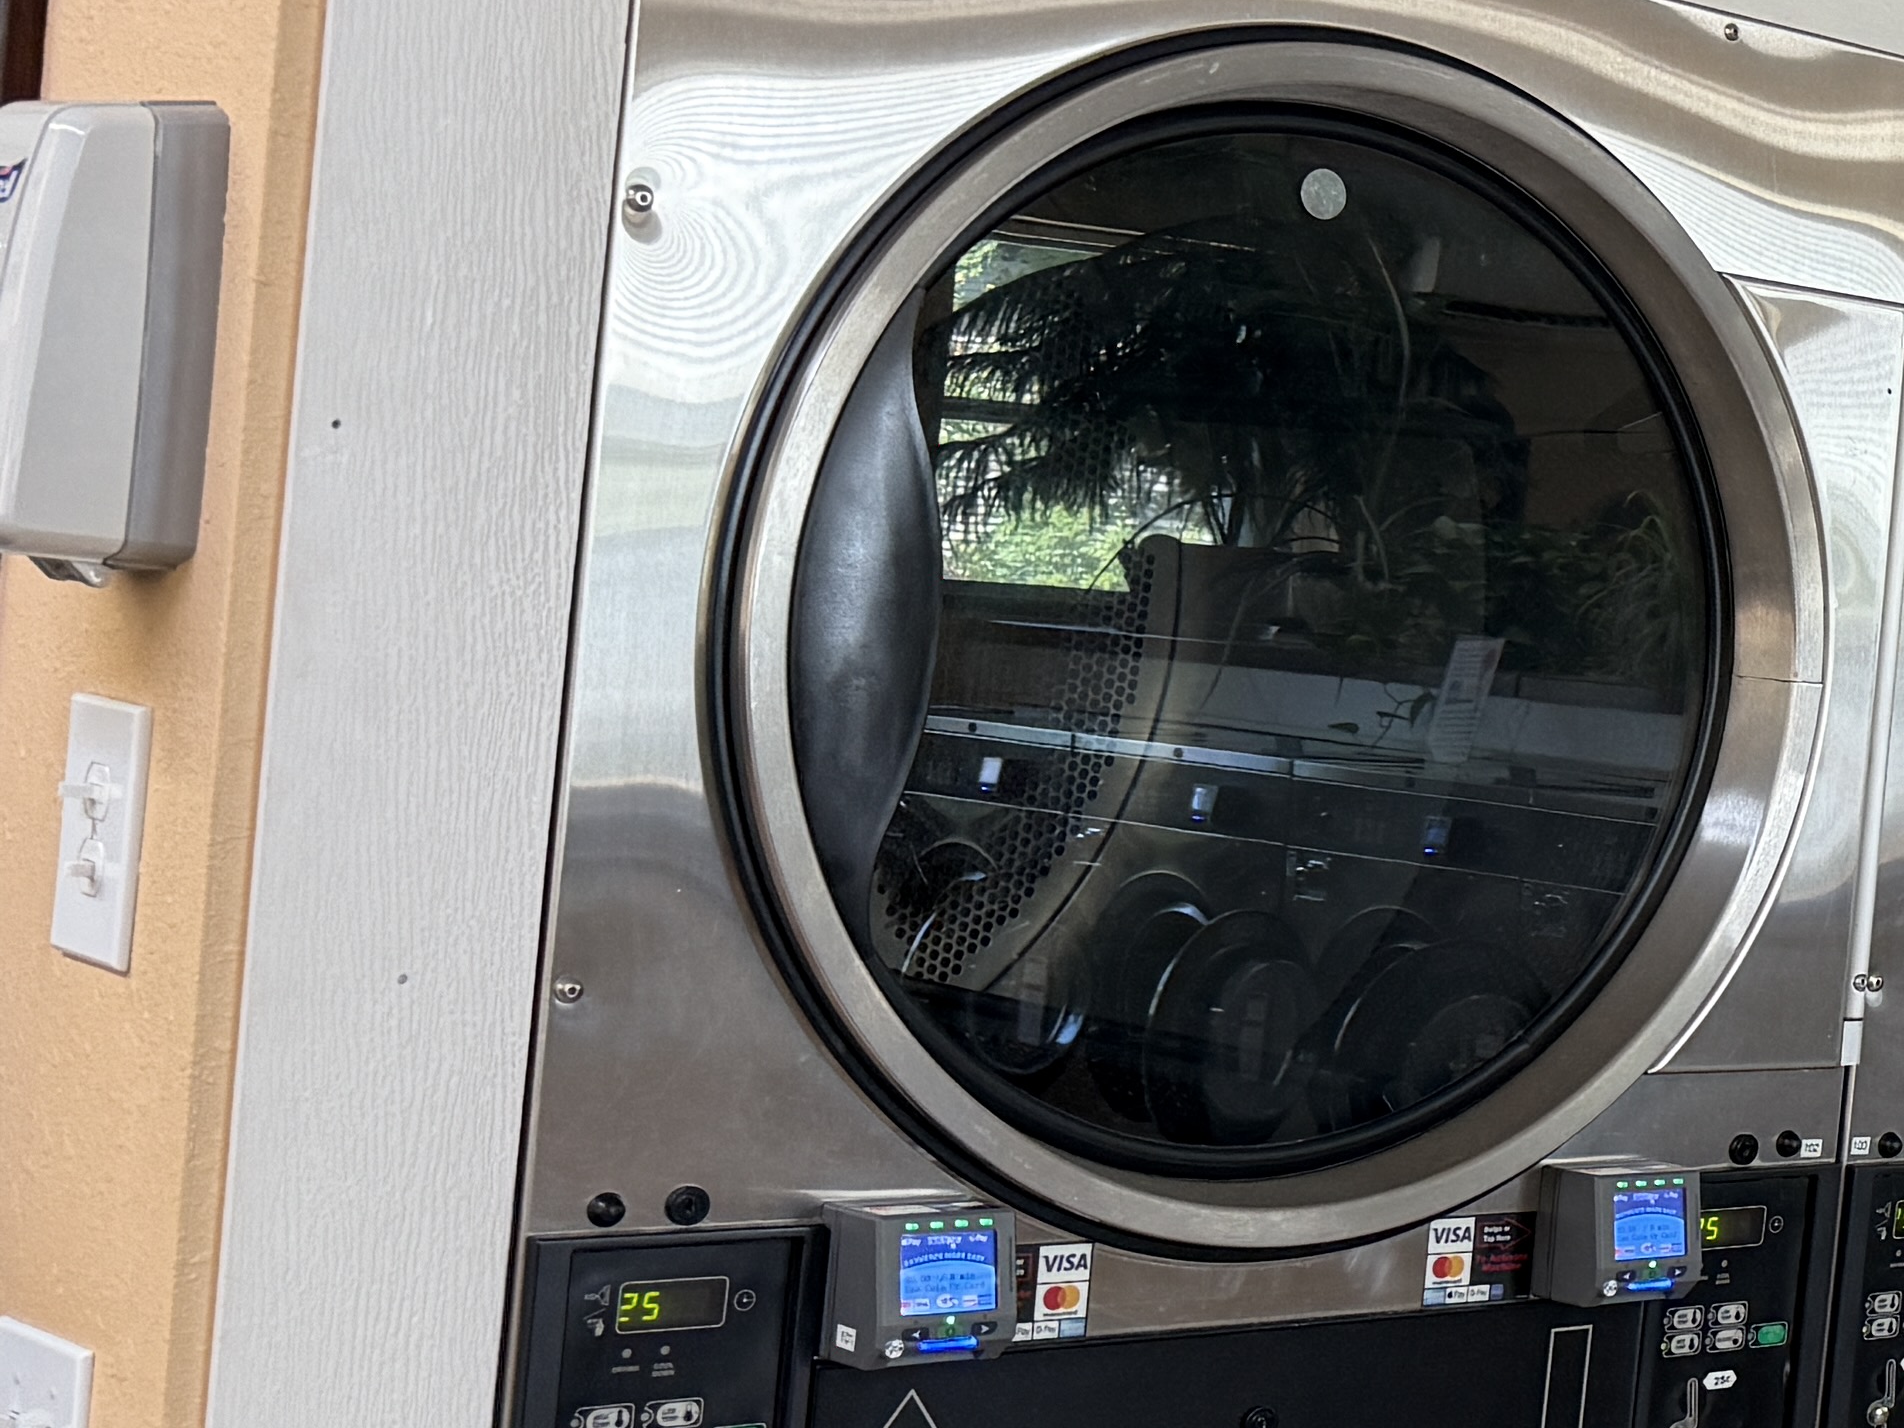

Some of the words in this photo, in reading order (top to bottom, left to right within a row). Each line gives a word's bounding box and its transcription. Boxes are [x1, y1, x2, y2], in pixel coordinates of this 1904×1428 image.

[1432, 1225, 1472, 1245] VISA
[1700, 1217, 1719, 1240] 5
[1042, 1253, 1089, 1273] VISA
